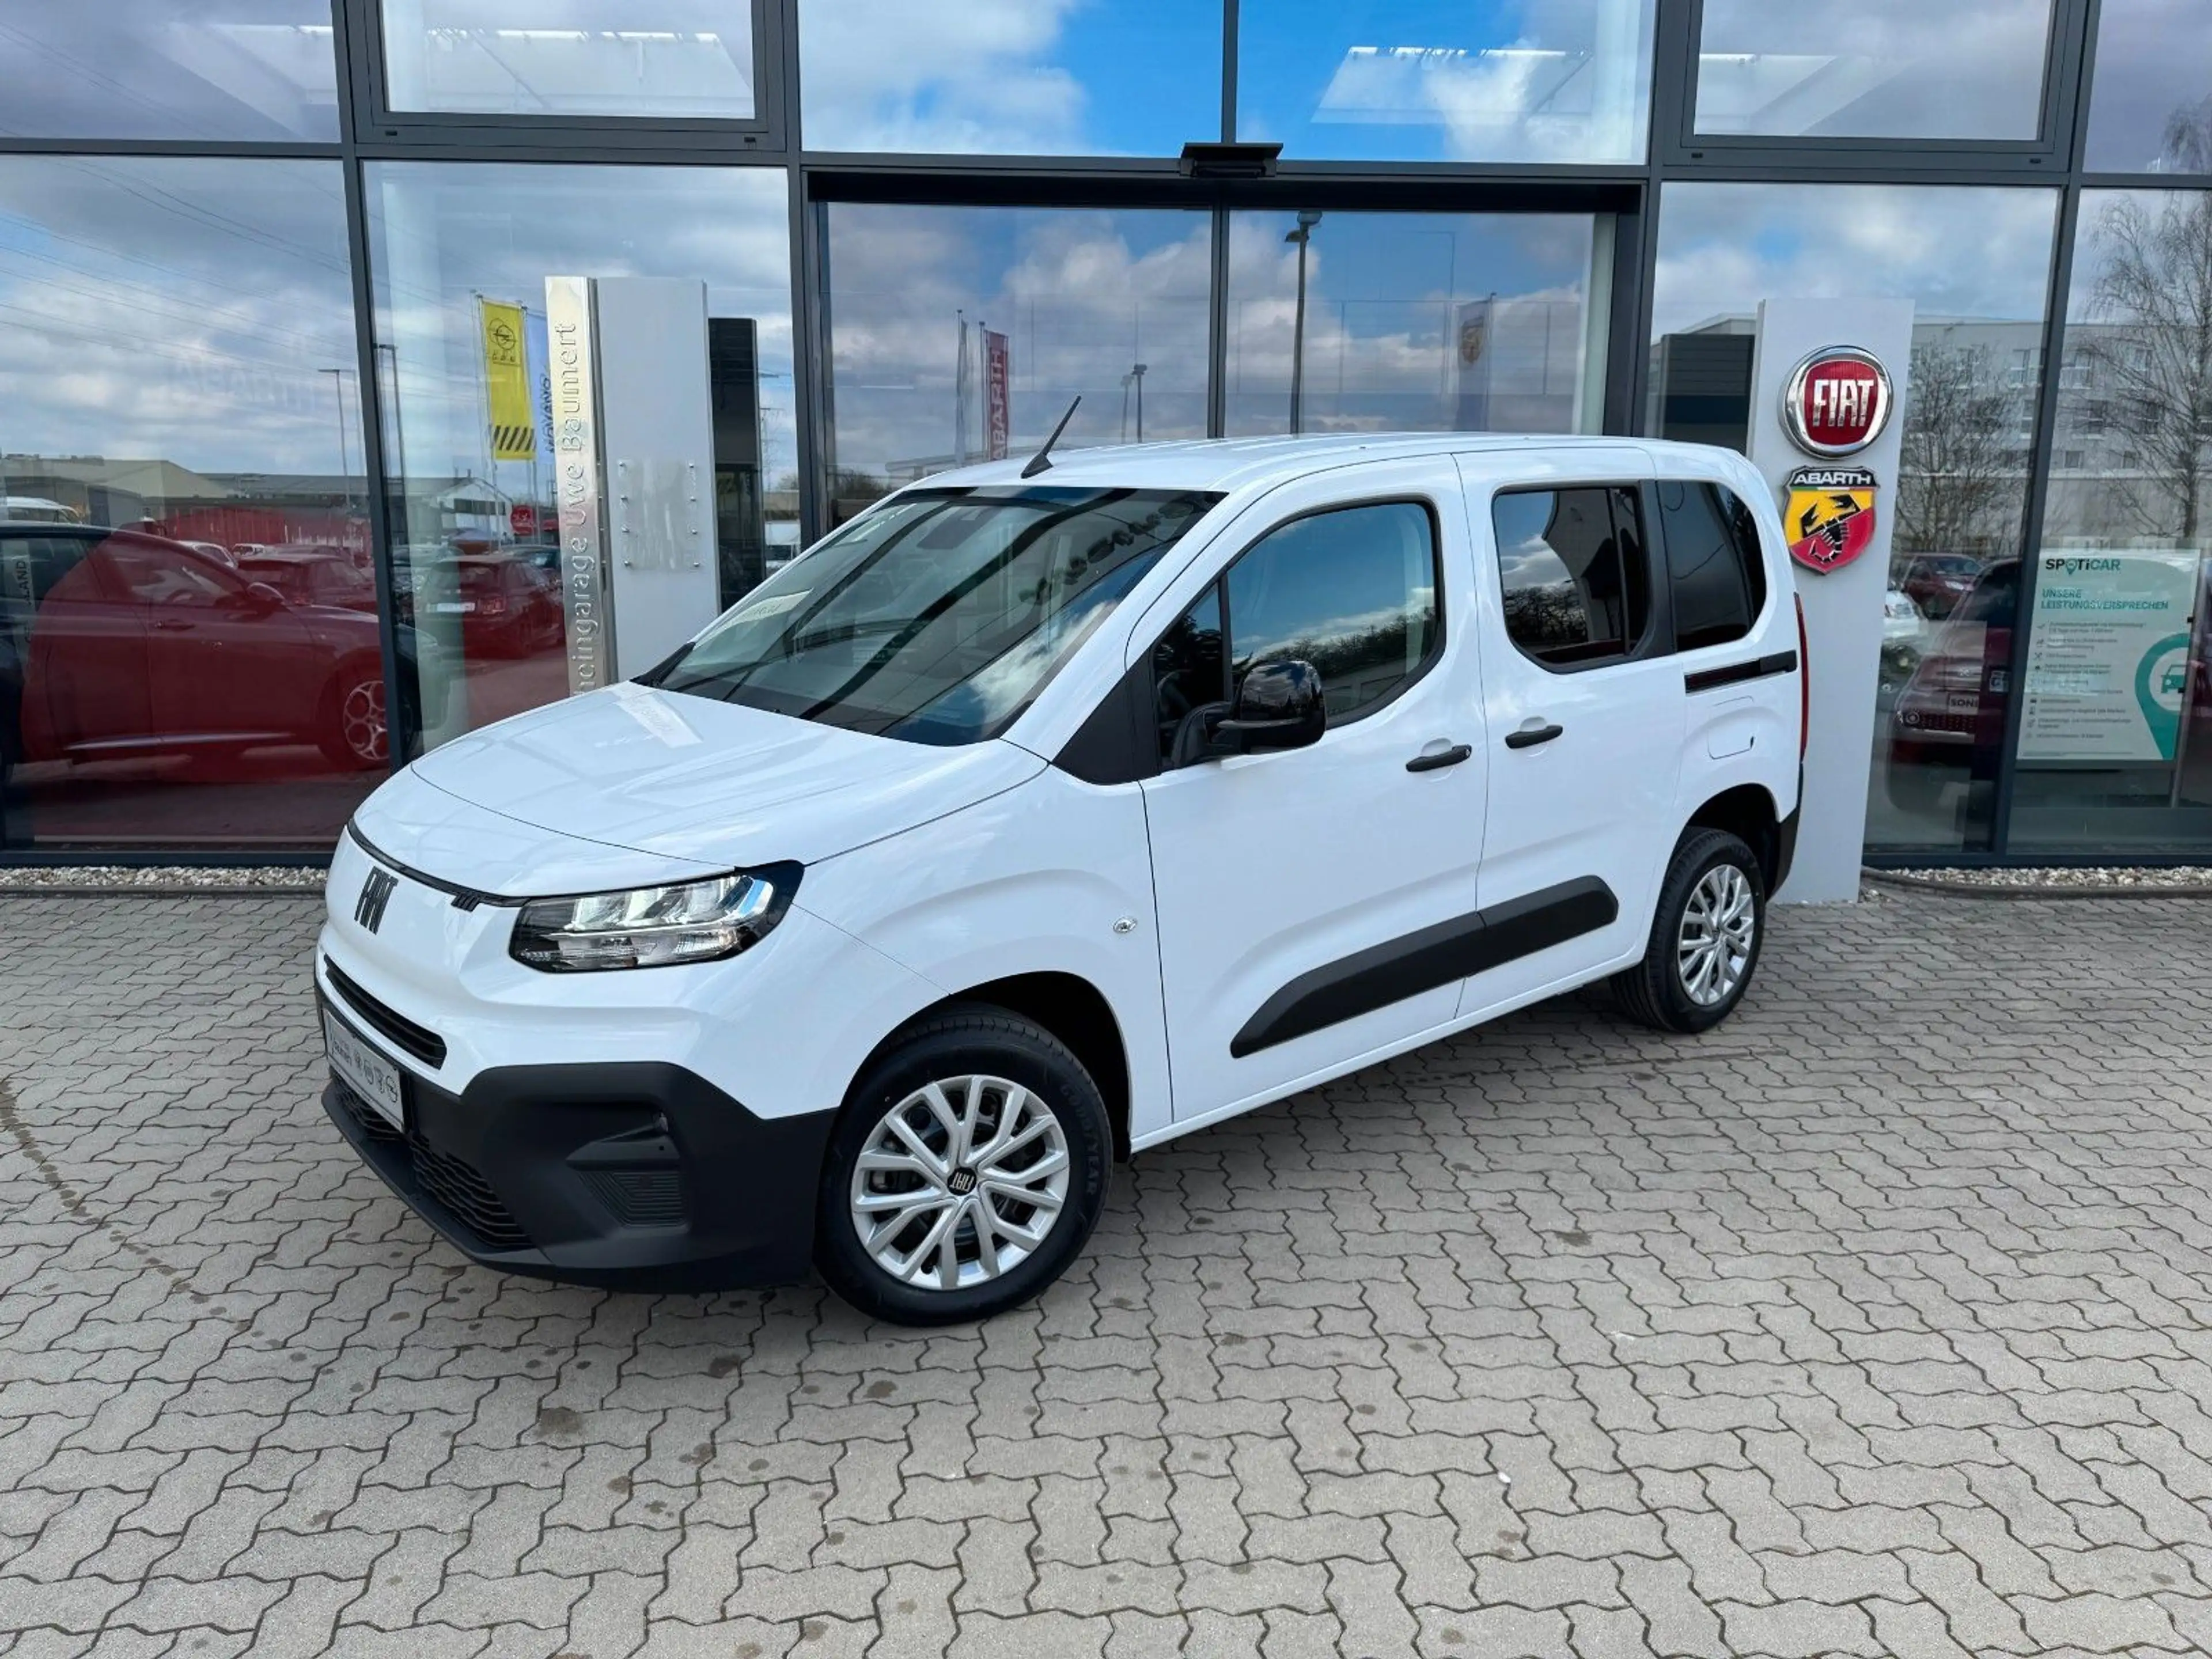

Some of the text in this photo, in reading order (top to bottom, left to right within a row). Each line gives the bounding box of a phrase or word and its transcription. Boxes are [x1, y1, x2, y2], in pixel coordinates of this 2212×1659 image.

[555, 323, 584, 452] Baumert
[1812, 378, 1874, 427] FIAT
[565, 463, 586, 527] Uwe
[1794, 471, 1872, 486] ABARTH
[2040, 600, 2169, 610] LEISTUNGSVERSPRECHEN
[2042, 588, 2082, 599] UNSERE
[354, 865, 399, 935] FIAT
